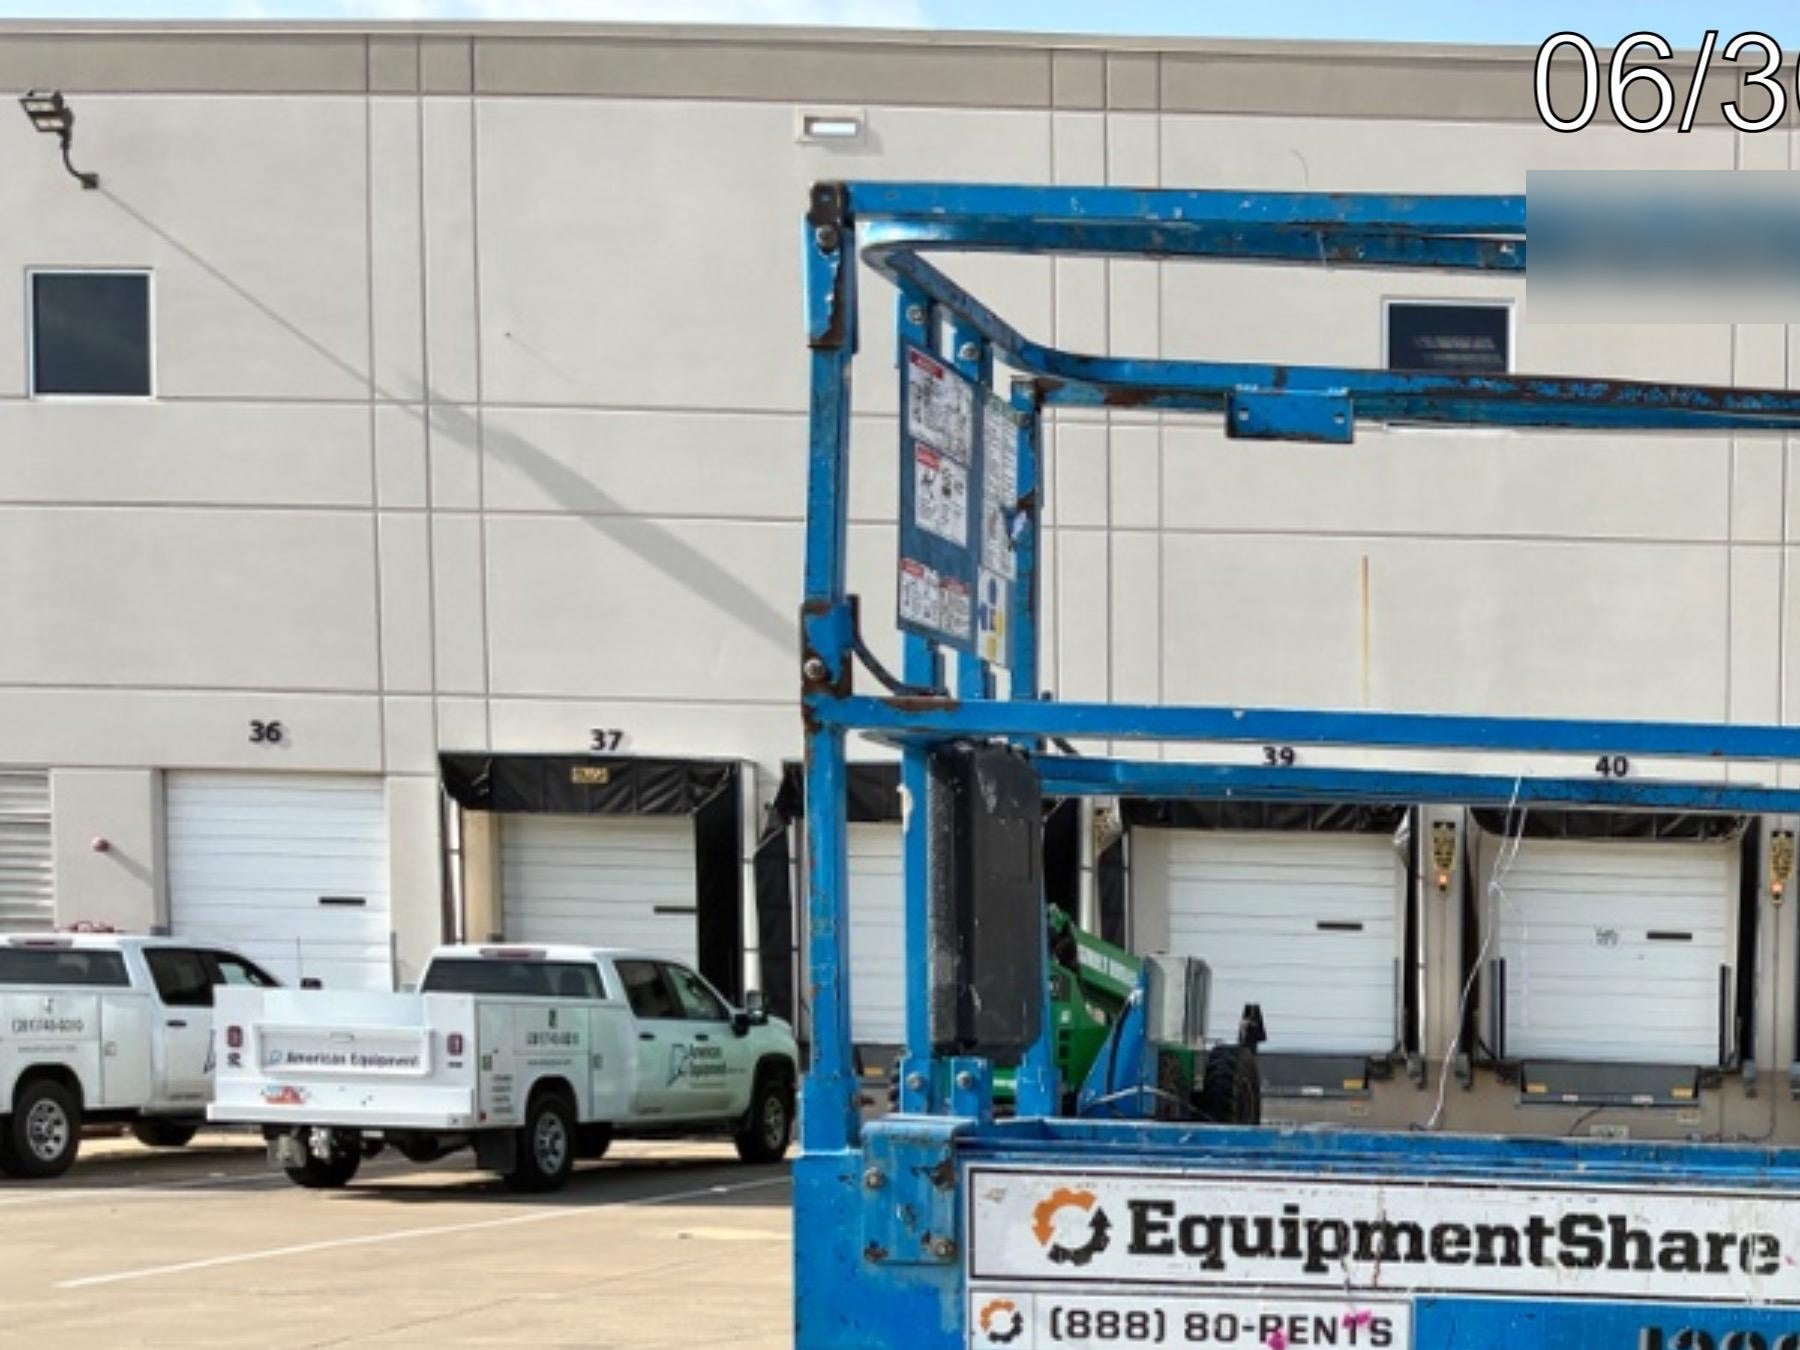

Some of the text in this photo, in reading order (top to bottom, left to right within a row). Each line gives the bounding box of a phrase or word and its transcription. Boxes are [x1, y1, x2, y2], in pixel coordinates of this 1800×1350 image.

[249, 721, 282, 743] 36
[591, 729, 623, 751] 37
[1262, 747, 1296, 767] 39
[1595, 755, 1630, 778] 40
[286, 1051, 418, 1067] American Equipment
[1126, 1199, 1782, 1276] EquipmentShare
[1049, 1306, 1394, 1347] (888) 80-RENTS
